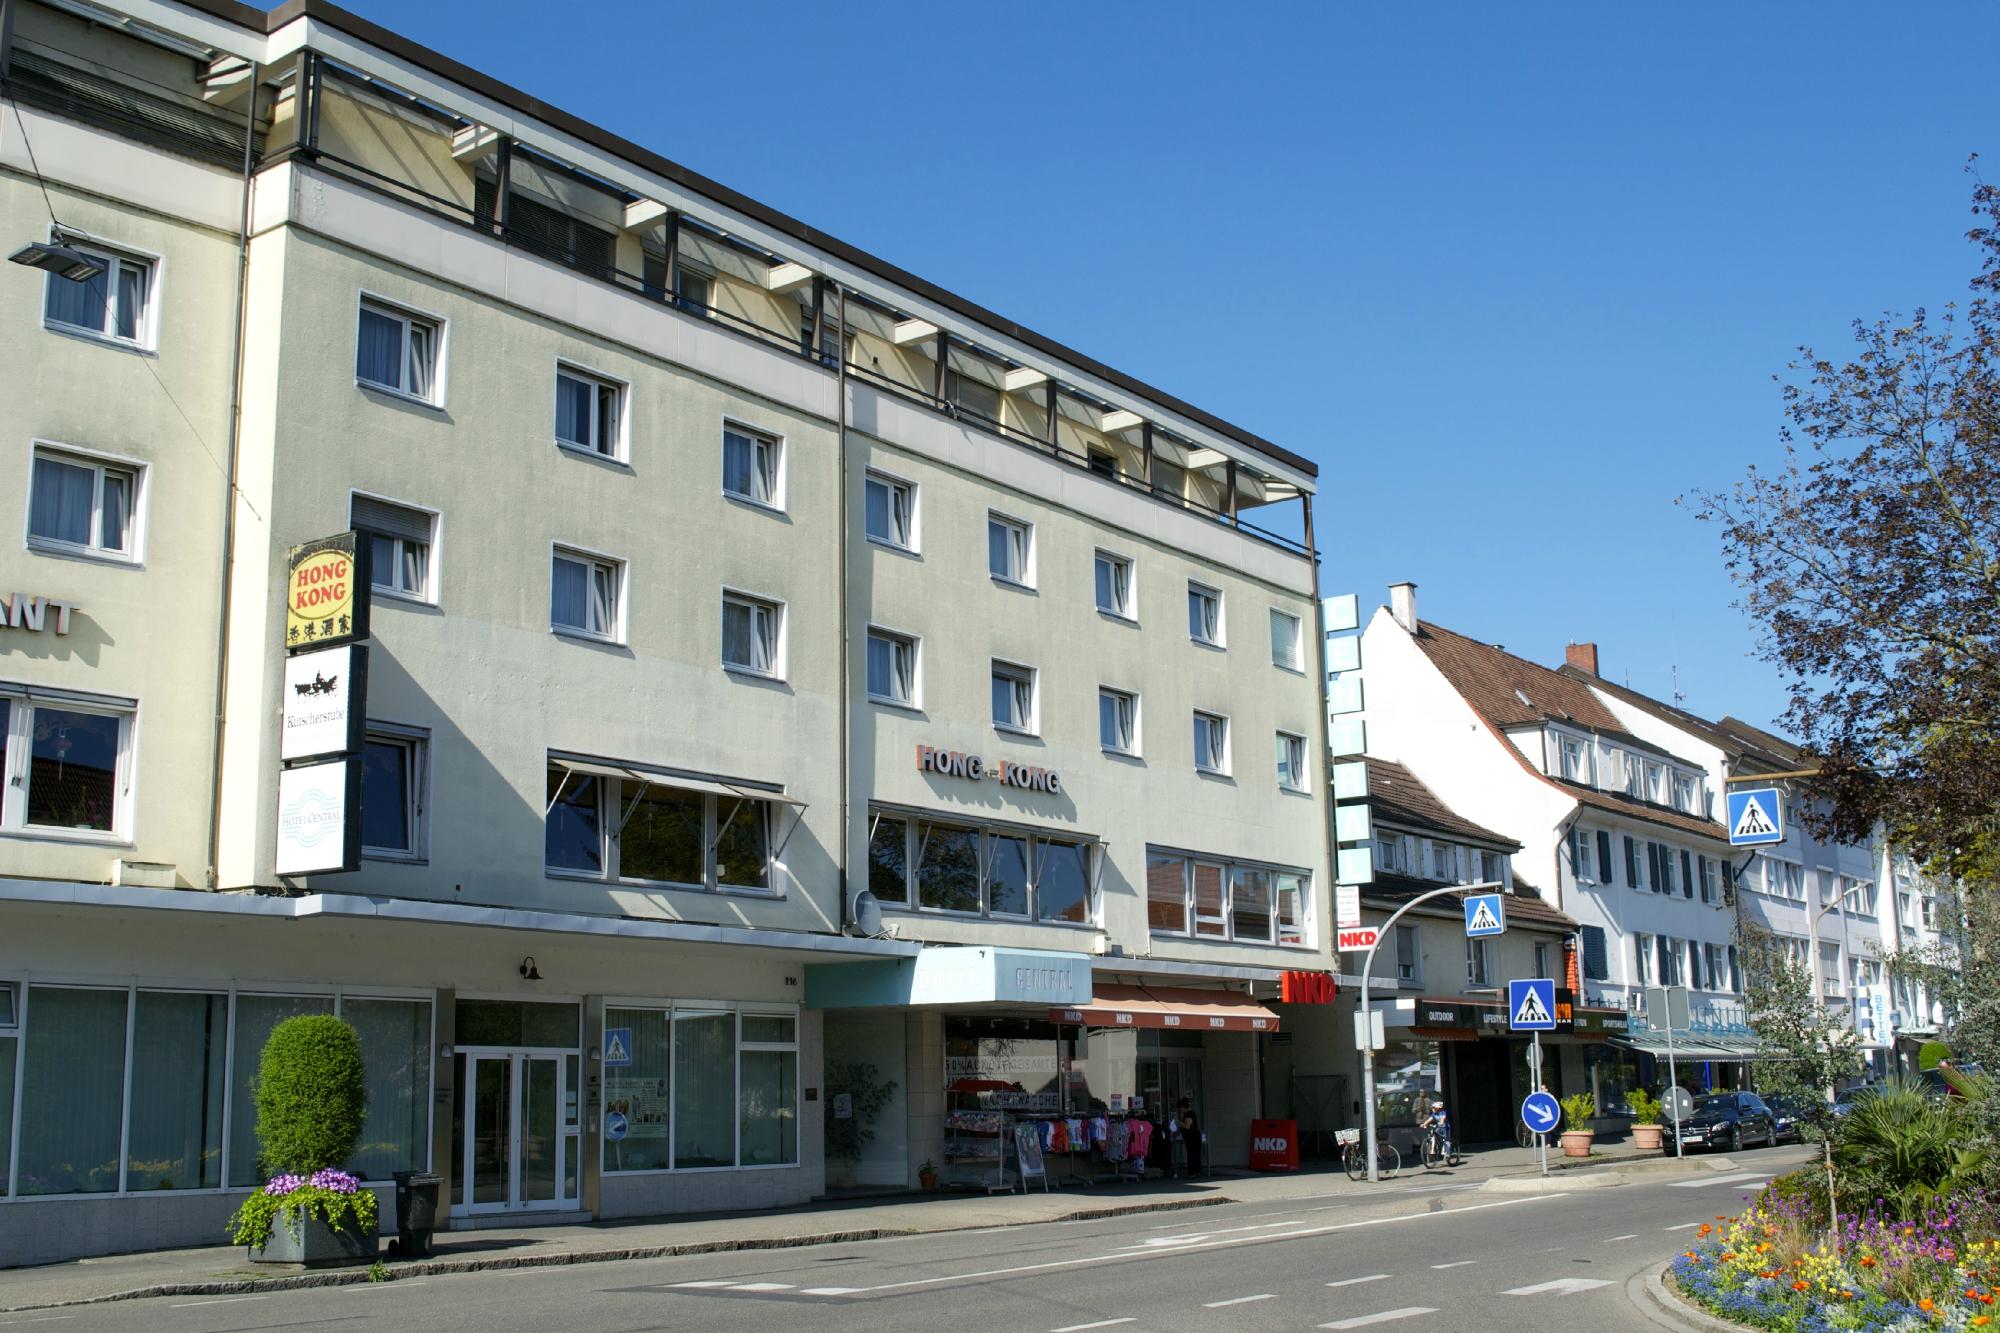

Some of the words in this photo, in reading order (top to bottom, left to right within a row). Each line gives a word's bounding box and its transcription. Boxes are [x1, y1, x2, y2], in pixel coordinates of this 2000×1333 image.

[297, 560, 347, 587] HONG
[296, 582, 346, 610] KONG
[0, 592, 82, 636] NT
[287, 707, 345, 729] Kutscherstube
[1327, 600, 1367, 884] CENTRAL
[916, 745, 983, 780] HONG
[1000, 760, 1061, 794] KONG
[282, 814, 307, 827] HOTEL
[308, 810, 341, 825] CENTRAL
[1339, 931, 1377, 948] NKD
[1016, 967, 1073, 992] CENTRAL
[1281, 970, 1336, 1004] NKD
[1064, 1010, 1083, 1022] NKD
[1116, 1013, 1132, 1024] NKD
[1164, 1015, 1180, 1026] NKD
[1210, 1017, 1225, 1028] NKD
[1252, 1019, 1267, 1029] NKD
[1429, 1011, 1454, 1021] OUTDOOR
[1483, 1014, 1508, 1024] LIFESTYLE
[1254, 1137, 1287, 1151] NKD
